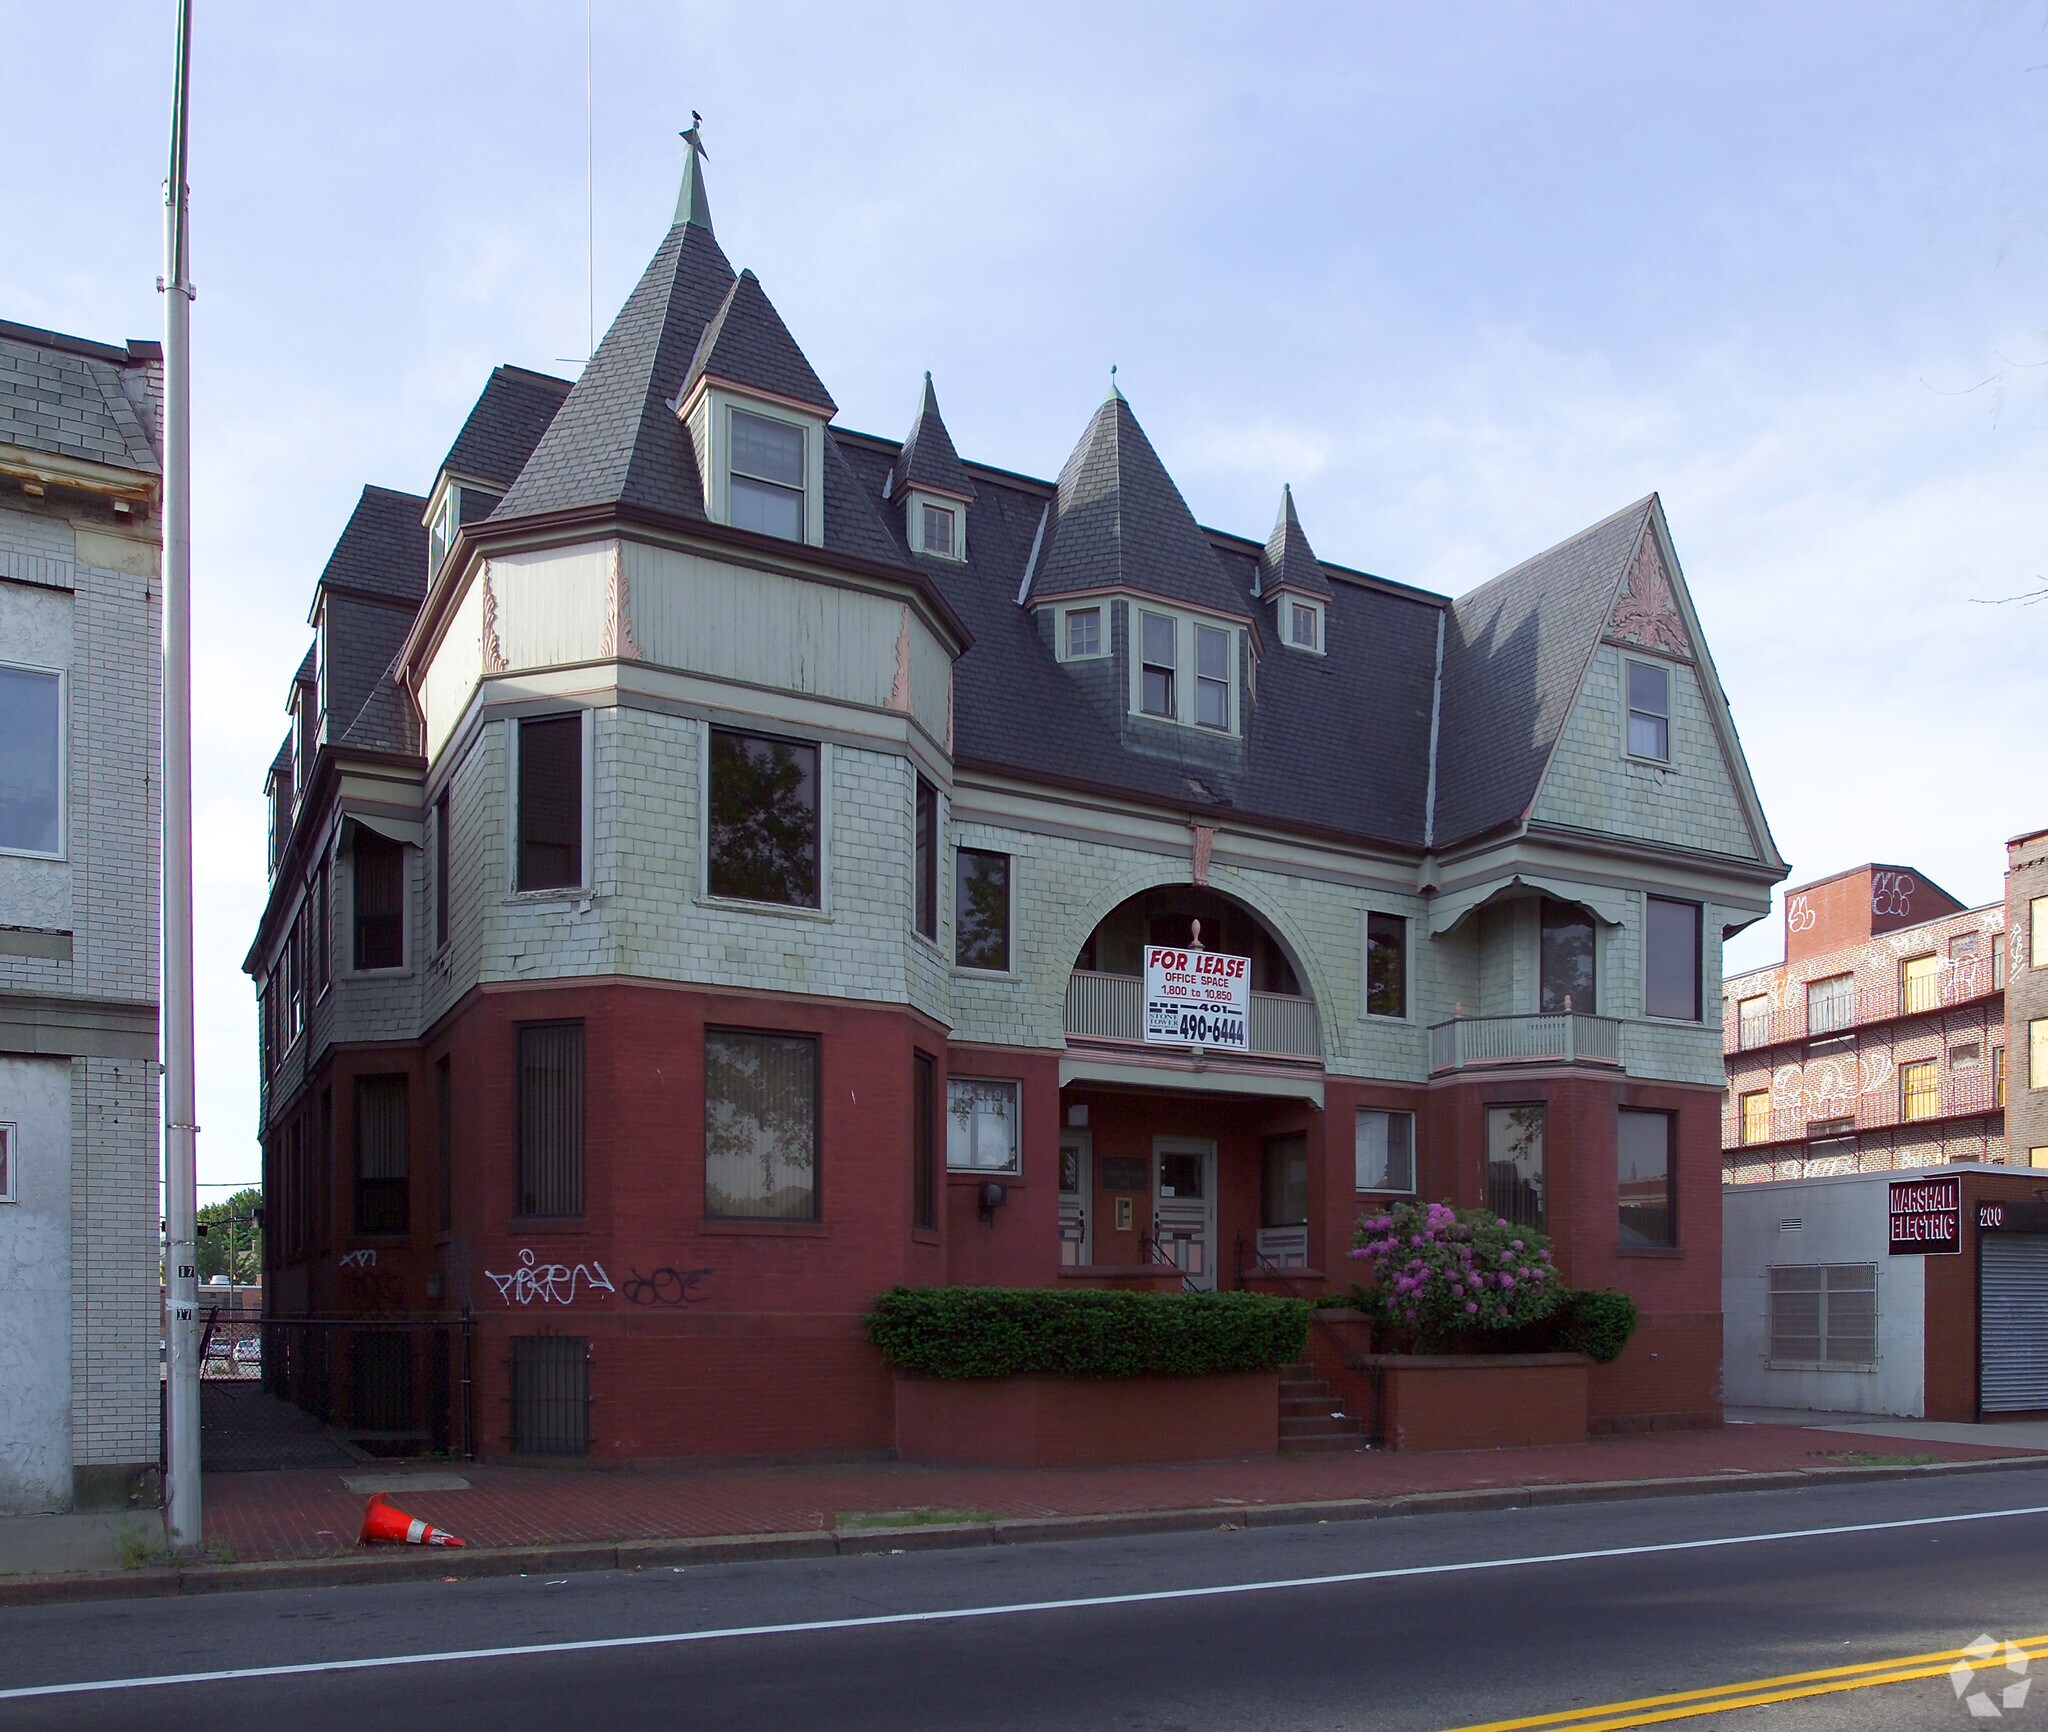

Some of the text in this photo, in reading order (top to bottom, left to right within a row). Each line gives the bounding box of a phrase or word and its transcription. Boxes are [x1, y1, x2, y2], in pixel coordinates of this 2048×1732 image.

[1149, 950, 1246, 979] FOR LEASE
[1165, 972, 1229, 988] OFFICE SPACE
[1161, 984, 1232, 1001] 1,800 to 10,850
[1199, 1003, 1228, 1014] 401
[1180, 1014, 1244, 1045] 490-6444
[1890, 1184, 1958, 1214] MARSHALL
[1979, 1206, 2003, 1227] 200
[1891, 1213, 1955, 1241] ELECTRIC
[179, 1266, 194, 1277] 17
[178, 1308, 191, 1320] 17
